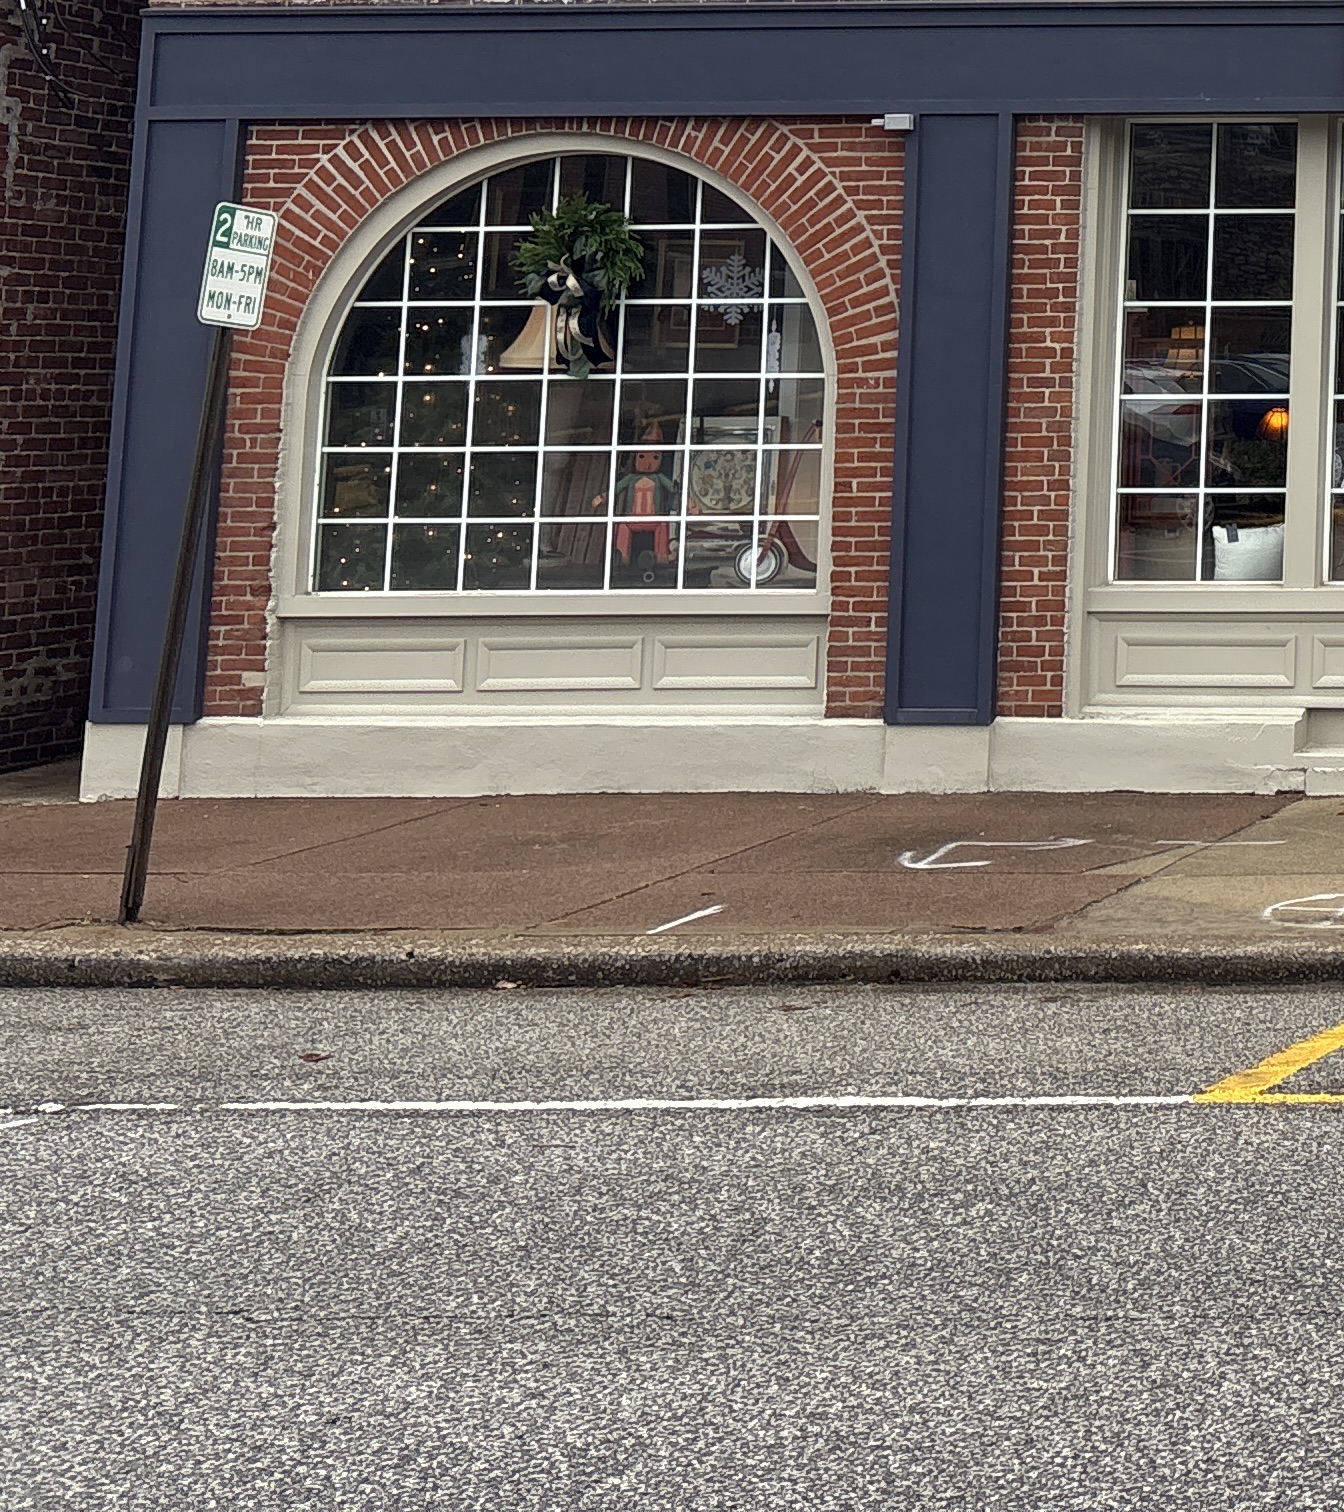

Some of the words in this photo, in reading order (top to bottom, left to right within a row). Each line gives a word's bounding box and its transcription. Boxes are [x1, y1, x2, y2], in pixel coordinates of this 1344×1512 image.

[215, 213, 231, 242] 2
[244, 215, 262, 232] HR
[232, 232, 269, 251] PARKING
[210, 259, 263, 285] 8AM-5PM
[206, 290, 257, 315] MON-FRI
